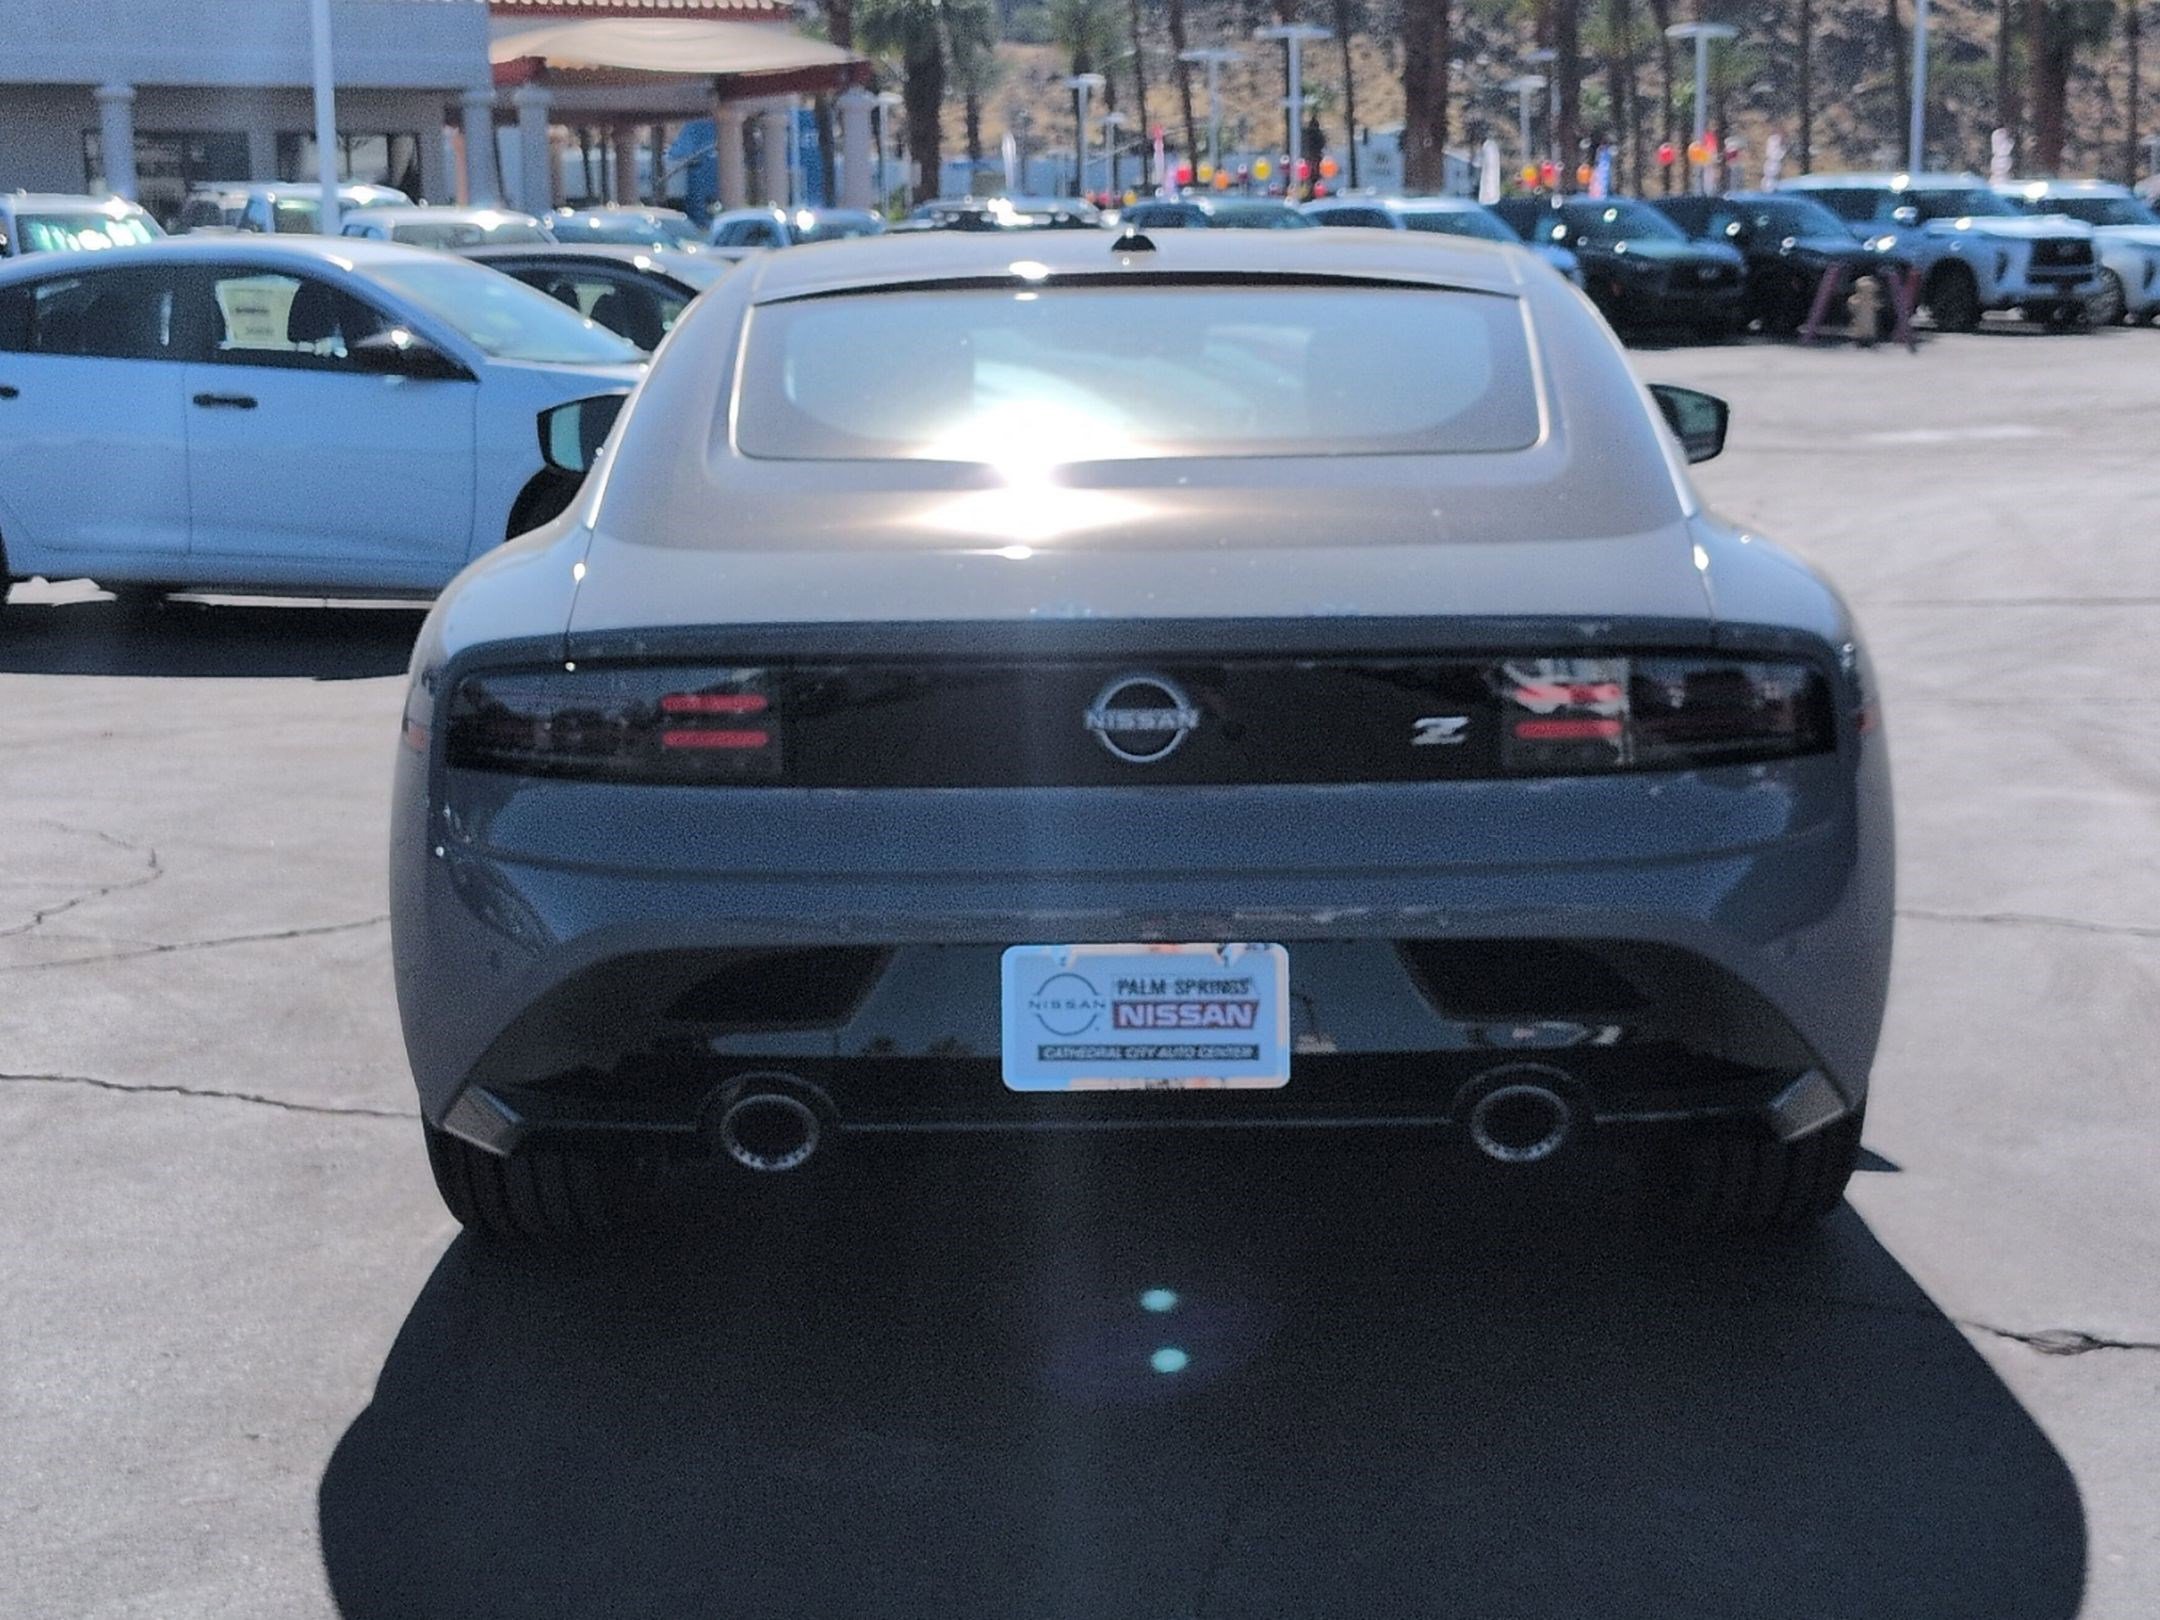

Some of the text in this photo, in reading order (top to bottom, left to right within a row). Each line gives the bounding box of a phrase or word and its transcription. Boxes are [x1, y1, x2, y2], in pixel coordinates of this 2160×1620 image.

[1085, 708, 1199, 730] NISSAN
[1412, 716, 1468, 745] Z
[1117, 977, 1250, 995] PALM SPRINGS
[1028, 1000, 1106, 1010] NISSAN
[1118, 1003, 1254, 1027] NISSAN
